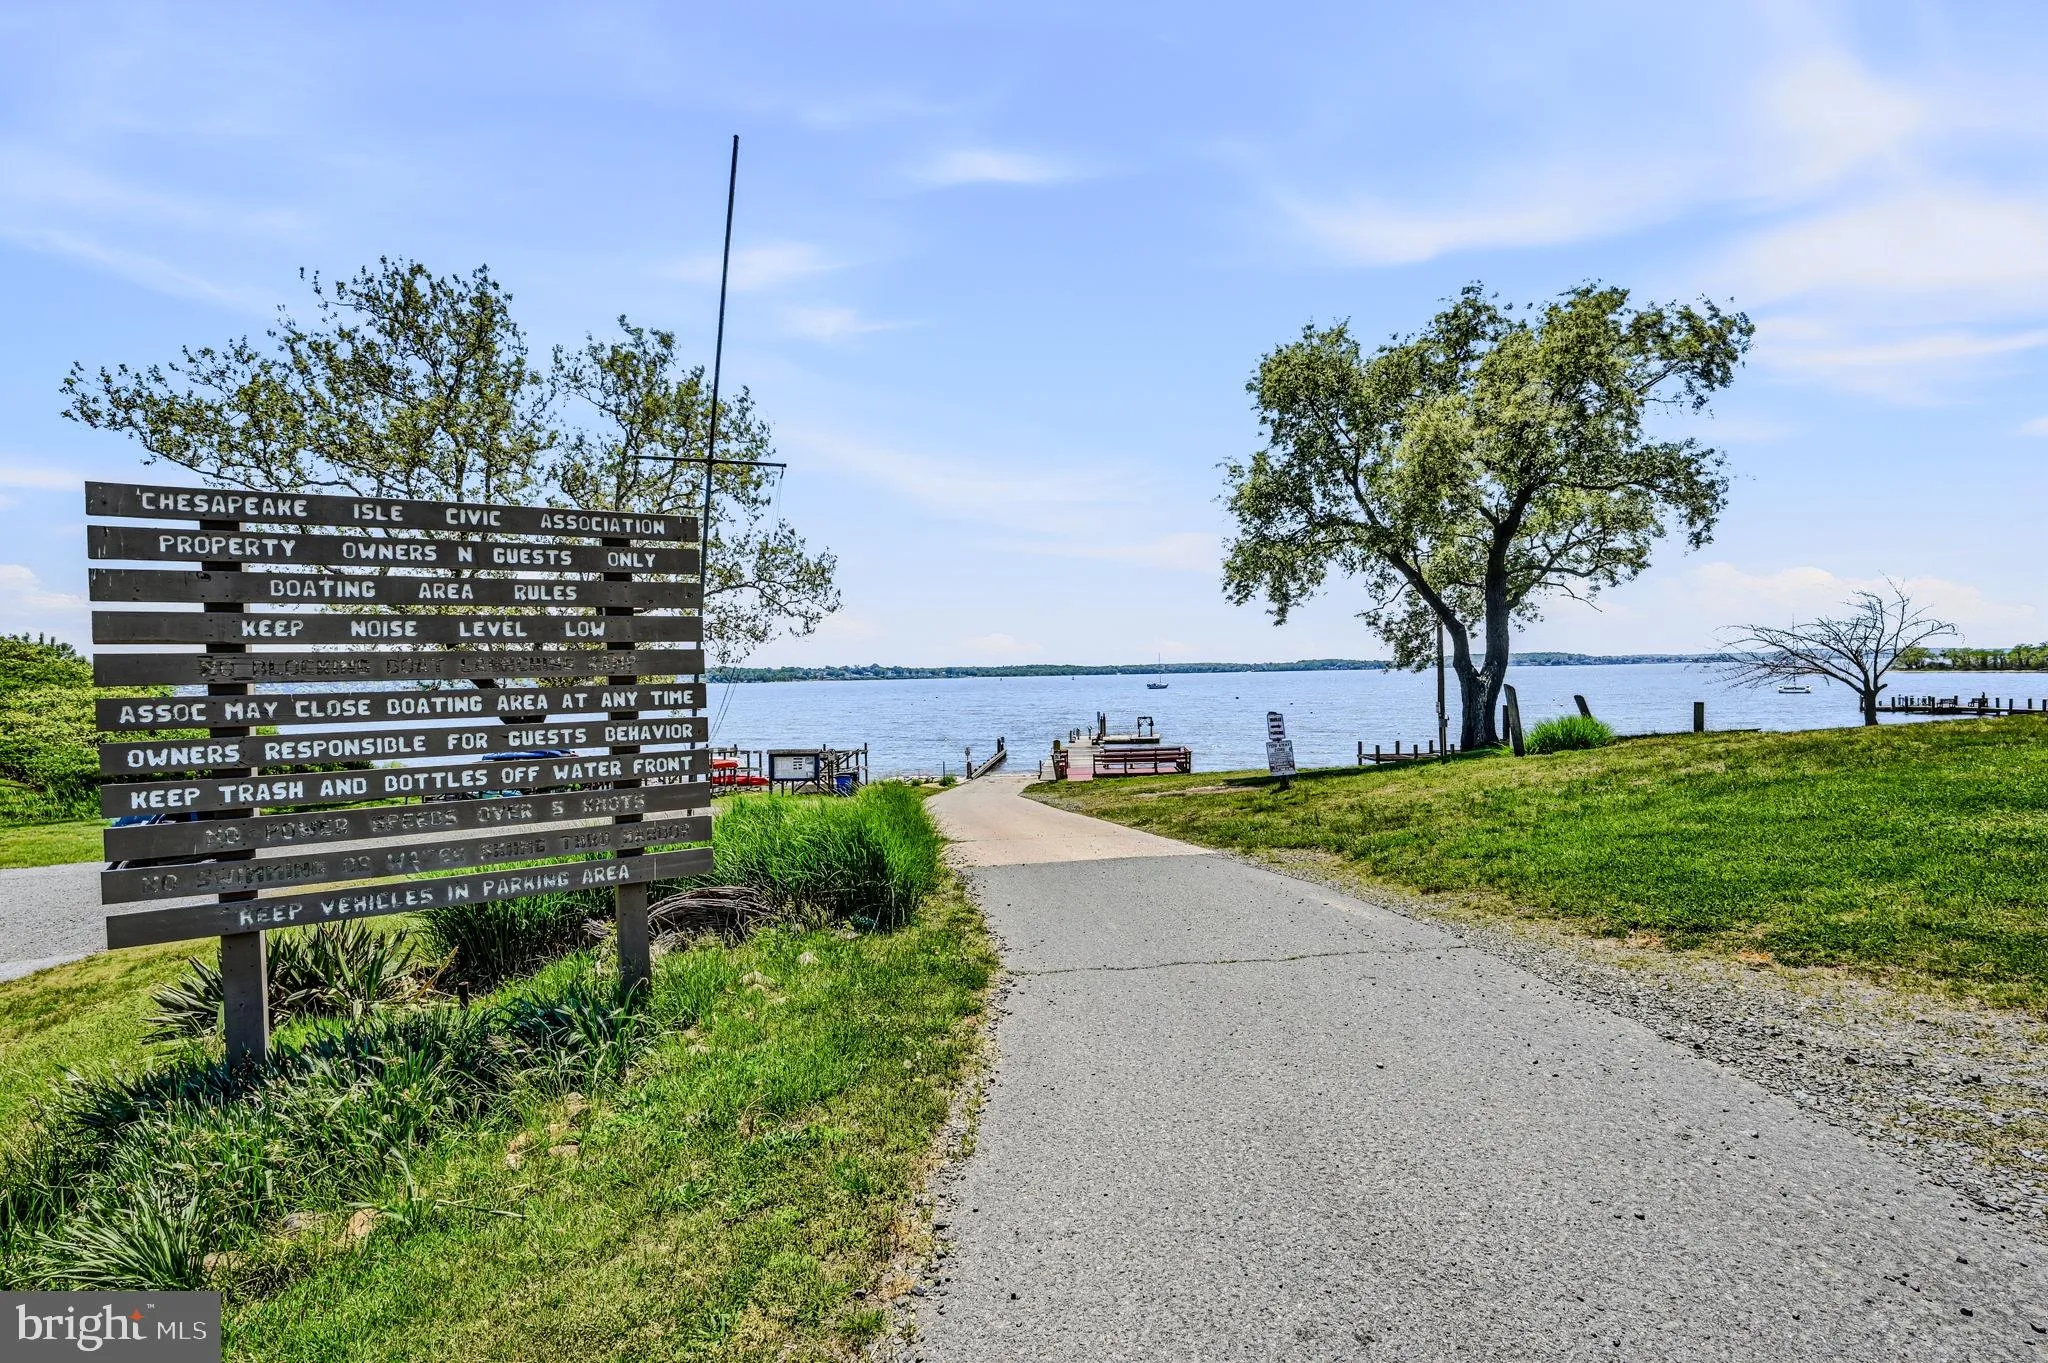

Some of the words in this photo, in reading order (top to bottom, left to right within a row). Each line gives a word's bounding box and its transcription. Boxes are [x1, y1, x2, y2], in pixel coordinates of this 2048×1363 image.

[141, 492, 308, 517] CHESAPEAKE
[353, 503, 403, 521] ISLE
[445, 508, 501, 526] CIVIC
[541, 513, 665, 535] ASSOCIATION
[159, 535, 296, 557] PROPERTY
[342, 542, 437, 561] OWNERS
[458, 546, 472, 563] N
[493, 548, 572, 565] GUESTS
[607, 552, 656, 568] ONLY
[270, 577, 376, 598] BOATING
[418, 583, 474, 600] AREA
[514, 584, 577, 600] RULES
[241, 619, 304, 637] KEEP
[350, 620, 418, 637] NOISE
[459, 621, 527, 637] LEVEL
[564, 621, 605, 637] LOW
[119, 703, 206, 724] ASSOC
[224, 701, 279, 720] MAY
[295, 699, 371, 718] CLOSE
[387, 695, 482, 715] BOATING
[497, 694, 548, 711] AREA
[561, 693, 588, 709] AT
[601, 691, 638, 708] ANY
[650, 689, 694, 705] TIME
[127, 744, 240, 768] OWNERS
[264, 735, 426, 761] RESPONSIBLE
[447, 732, 488, 750] FOR
[508, 727, 587, 747] GUESTS
[604, 723, 693, 743] BEHAVIOR
[130, 787, 201, 810] KEEP
[219, 780, 303, 802] TRASH
[320, 777, 367, 797] AND
[384, 769, 488, 792] BOTTLES
[501, 766, 540, 784] OFF
[552, 760, 622, 780] WATER
[633, 755, 693, 774] FRONT
[205, 826, 240, 845] NO
[476, 803, 533, 822] OVER
[582, 794, 646, 812] KNOTS
[239, 903, 303, 926] KEEP
[321, 888, 433, 915] VEHICLES
[447, 882, 469, 900] IN
[483, 871, 569, 896] PARKING
[582, 864, 630, 884] AREA
